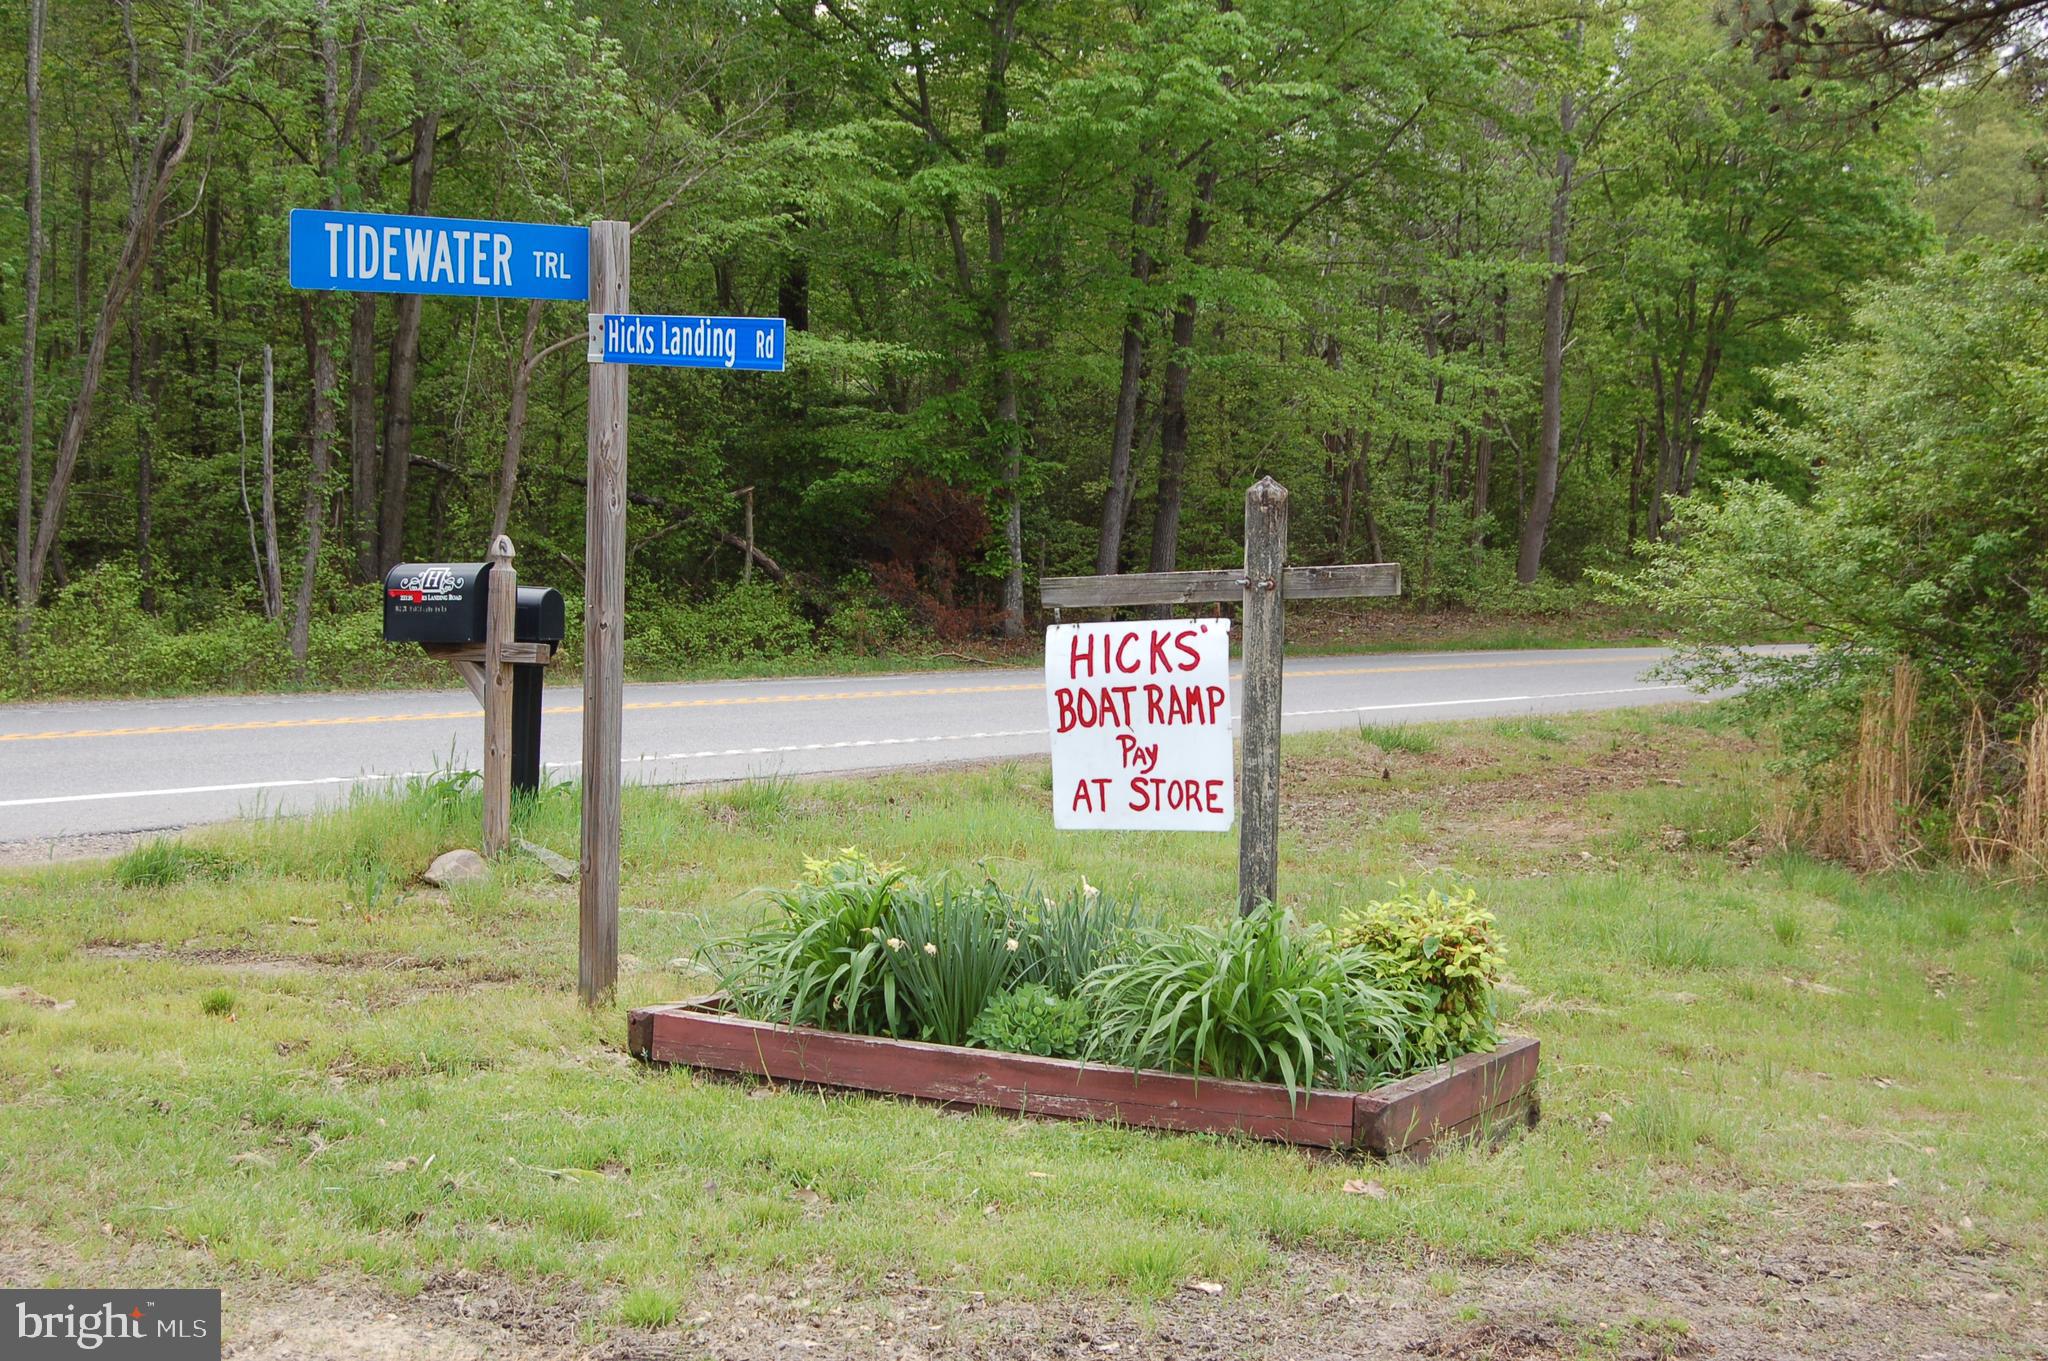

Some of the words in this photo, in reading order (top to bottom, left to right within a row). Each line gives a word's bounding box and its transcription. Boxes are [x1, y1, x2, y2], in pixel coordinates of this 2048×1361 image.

[324, 222, 513, 286] TIDEWATER
[533, 250, 571, 280] TRL
[608, 317, 654, 355] Hicks
[662, 320, 736, 368] Landing
[756, 328, 774, 359] Rd
[424, 570, 444, 588] H
[1070, 624, 1208, 680] HICKS'
[1055, 685, 1137, 733] BOAT
[1143, 683, 1226, 725] RAMP
[1073, 778, 1113, 813] AT
[1129, 776, 1224, 813] STORE
